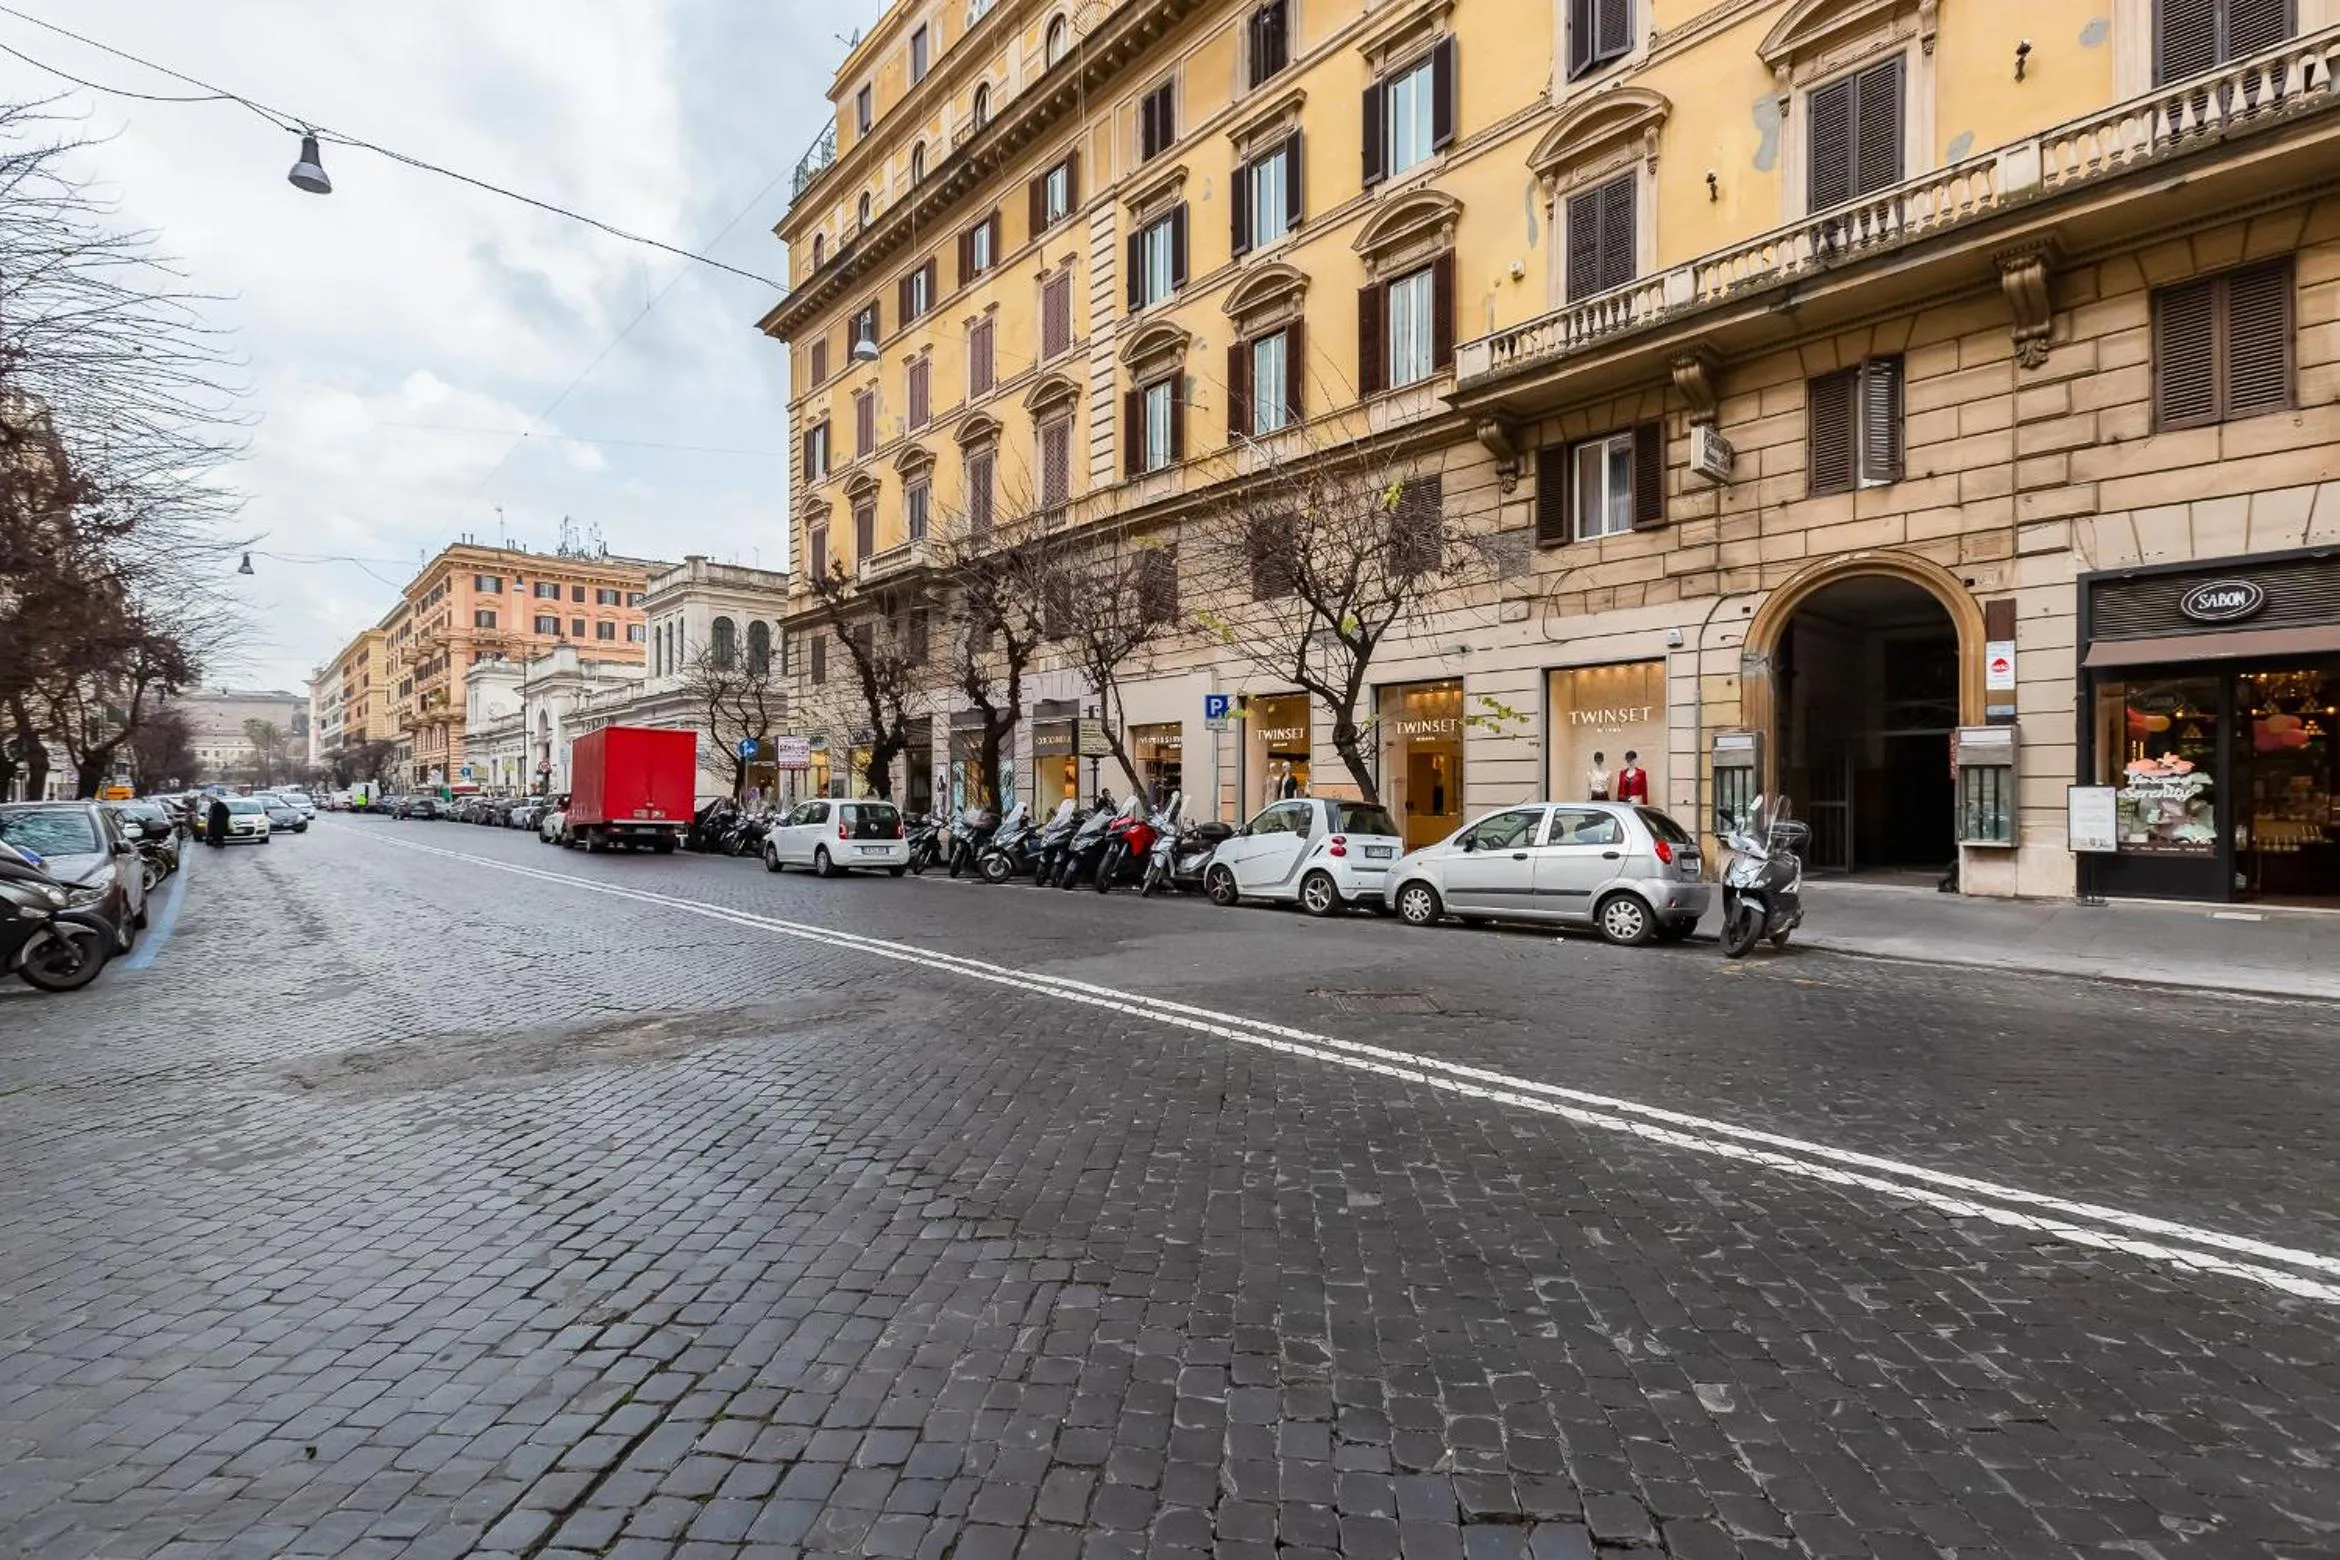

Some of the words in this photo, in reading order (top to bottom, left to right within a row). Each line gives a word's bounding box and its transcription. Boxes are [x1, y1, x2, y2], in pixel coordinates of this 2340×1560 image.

[2198, 590, 2246, 609] SABON
[1210, 698, 1223, 715] P
[1567, 706, 1654, 725] TWINSET
[1256, 727, 1304, 741] TWINSET
[1395, 718, 1458, 735] TWINSET
